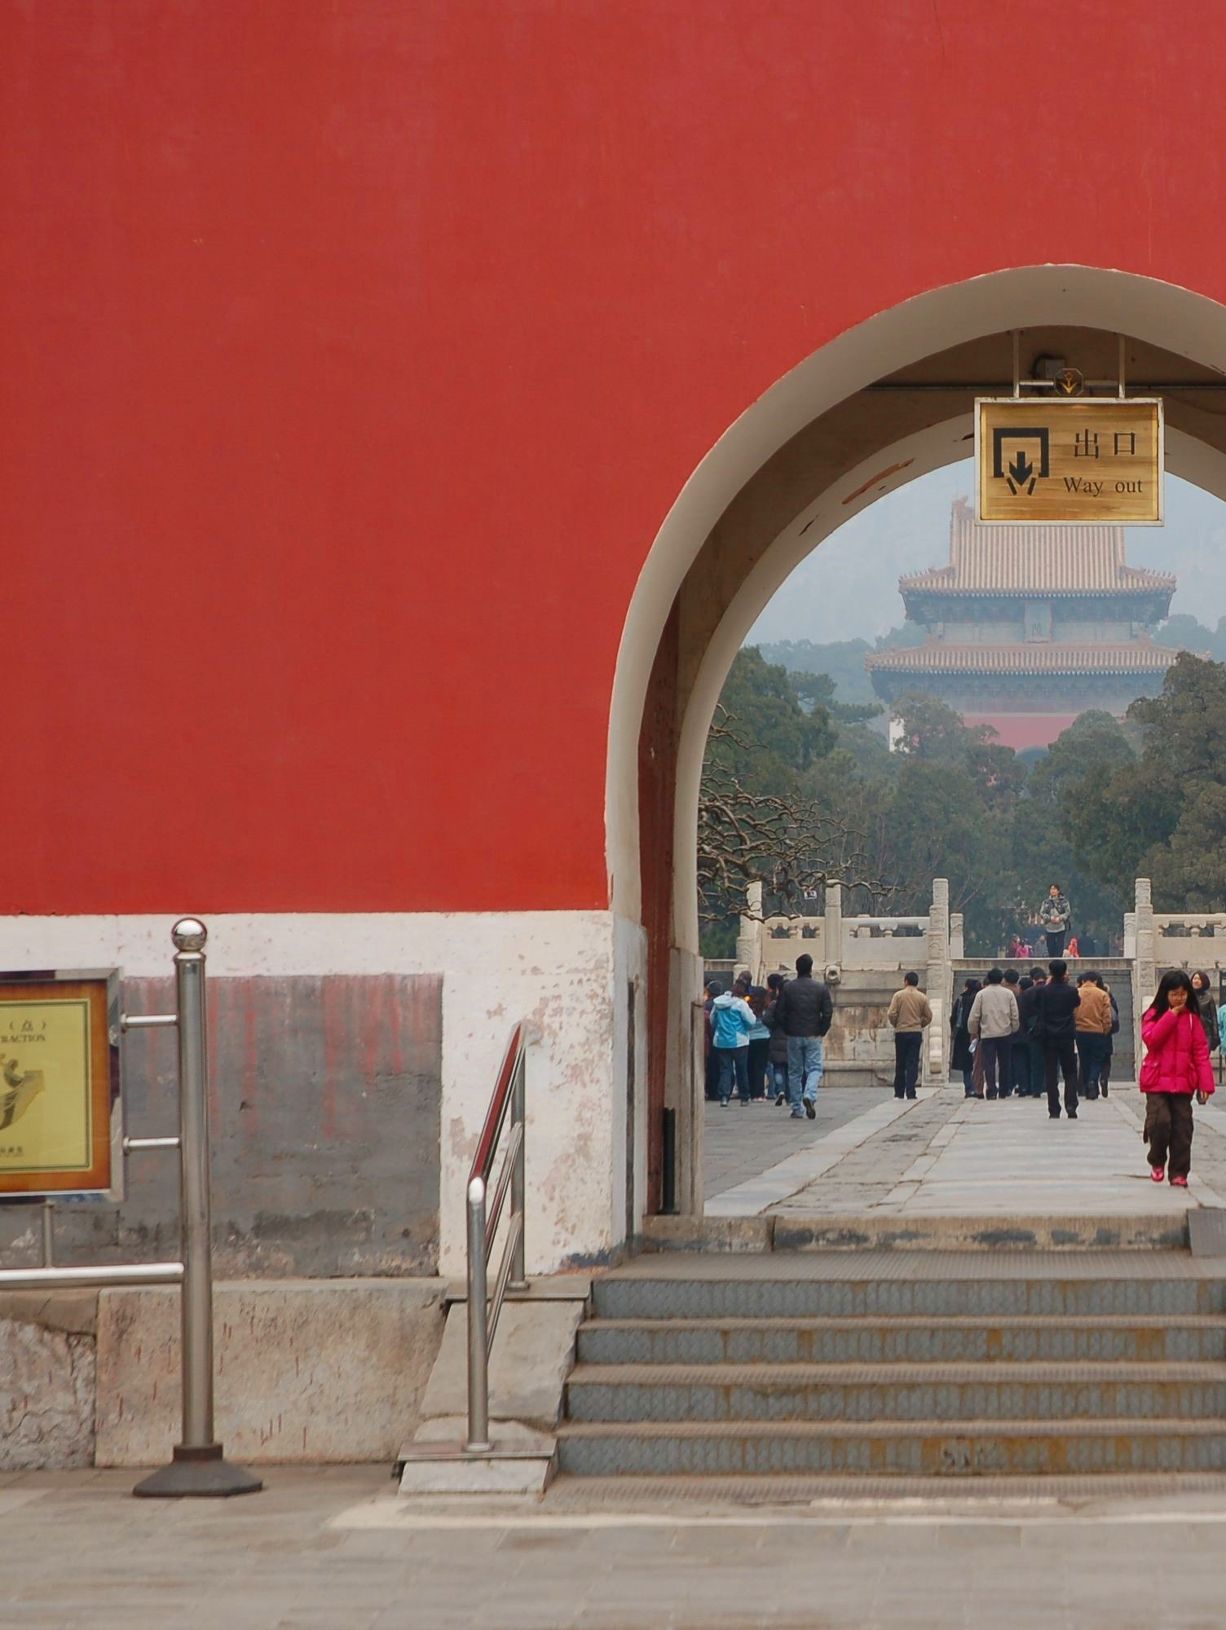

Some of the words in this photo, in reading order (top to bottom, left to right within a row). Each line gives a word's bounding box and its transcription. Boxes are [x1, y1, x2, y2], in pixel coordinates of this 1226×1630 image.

[1074, 428, 1136, 459] 出口
[1063, 476, 1103, 497] Way
[1115, 478, 1143, 493] out
